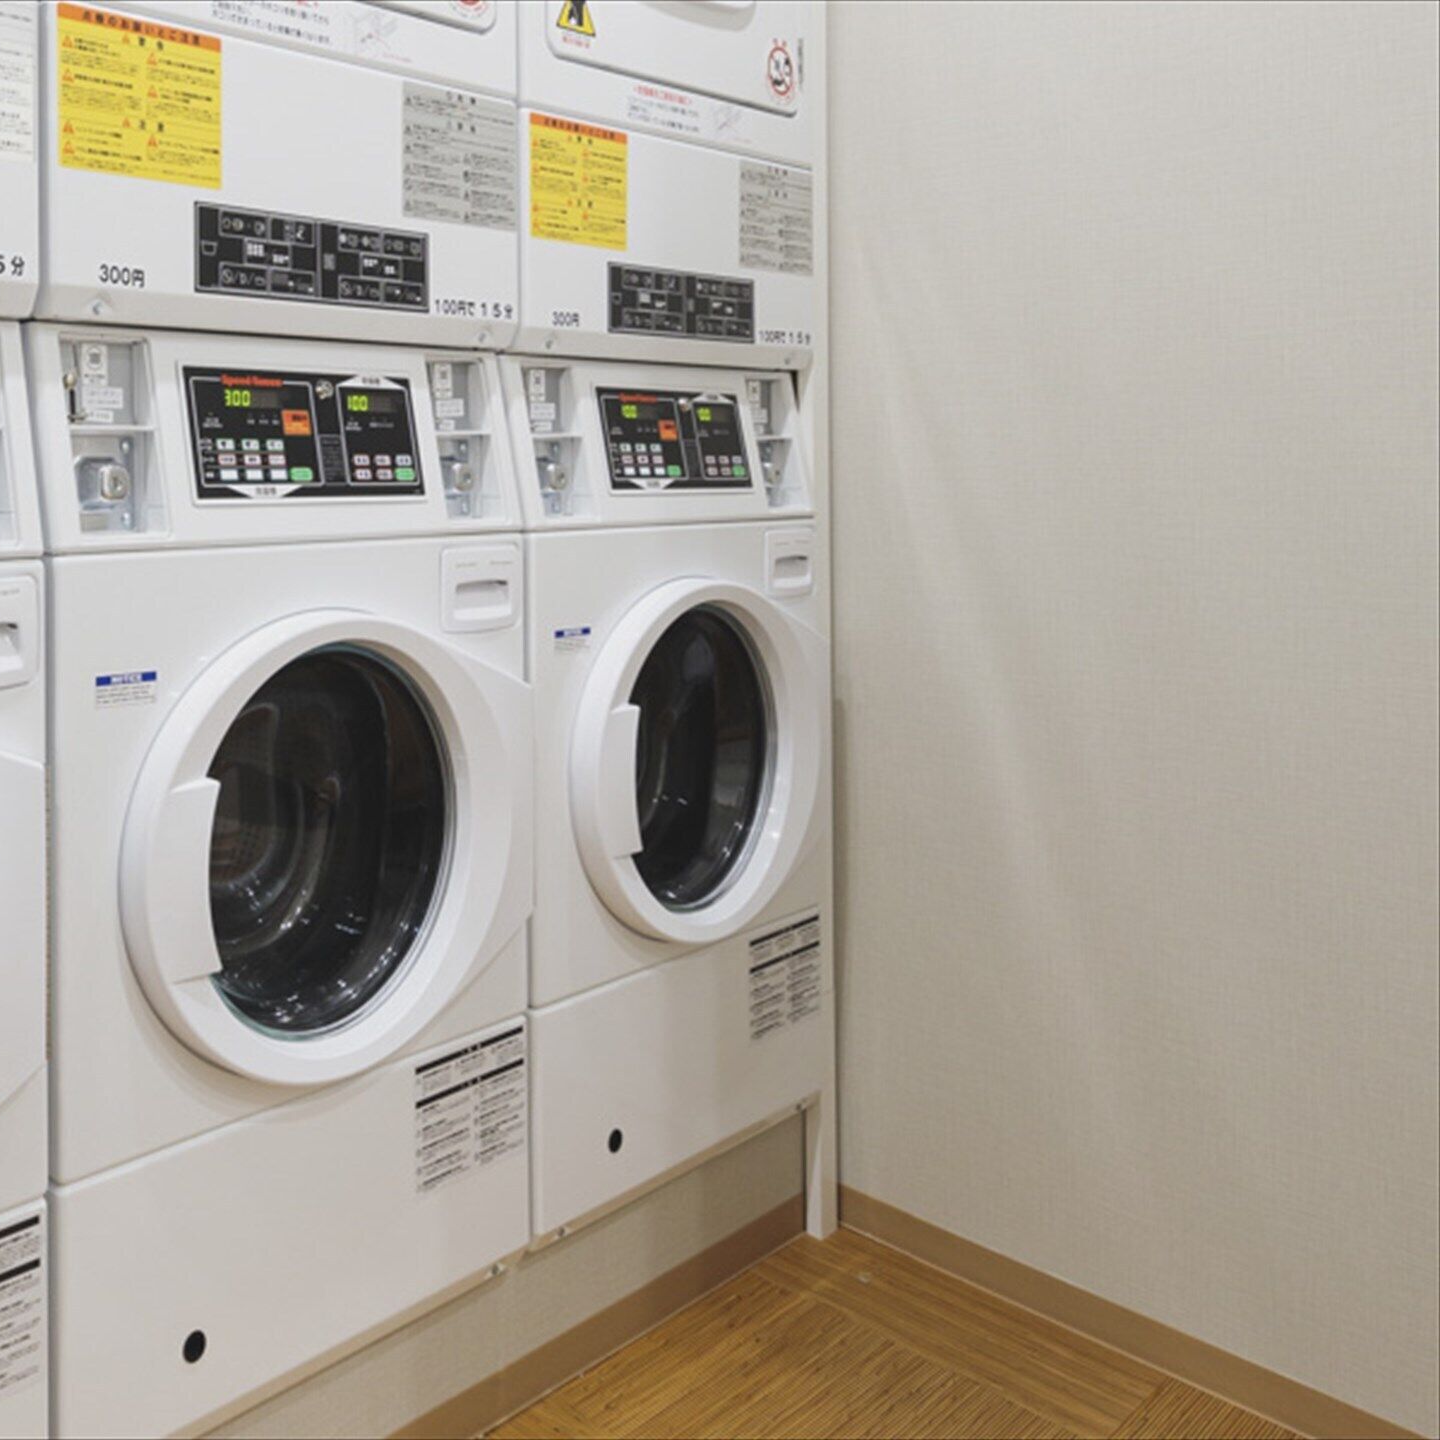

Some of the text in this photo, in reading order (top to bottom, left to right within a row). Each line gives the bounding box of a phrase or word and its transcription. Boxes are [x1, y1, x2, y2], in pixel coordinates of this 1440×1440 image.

[98, 263, 145, 288] 300円
[223, 388, 251, 407] 300
[347, 395, 369, 411] 100
